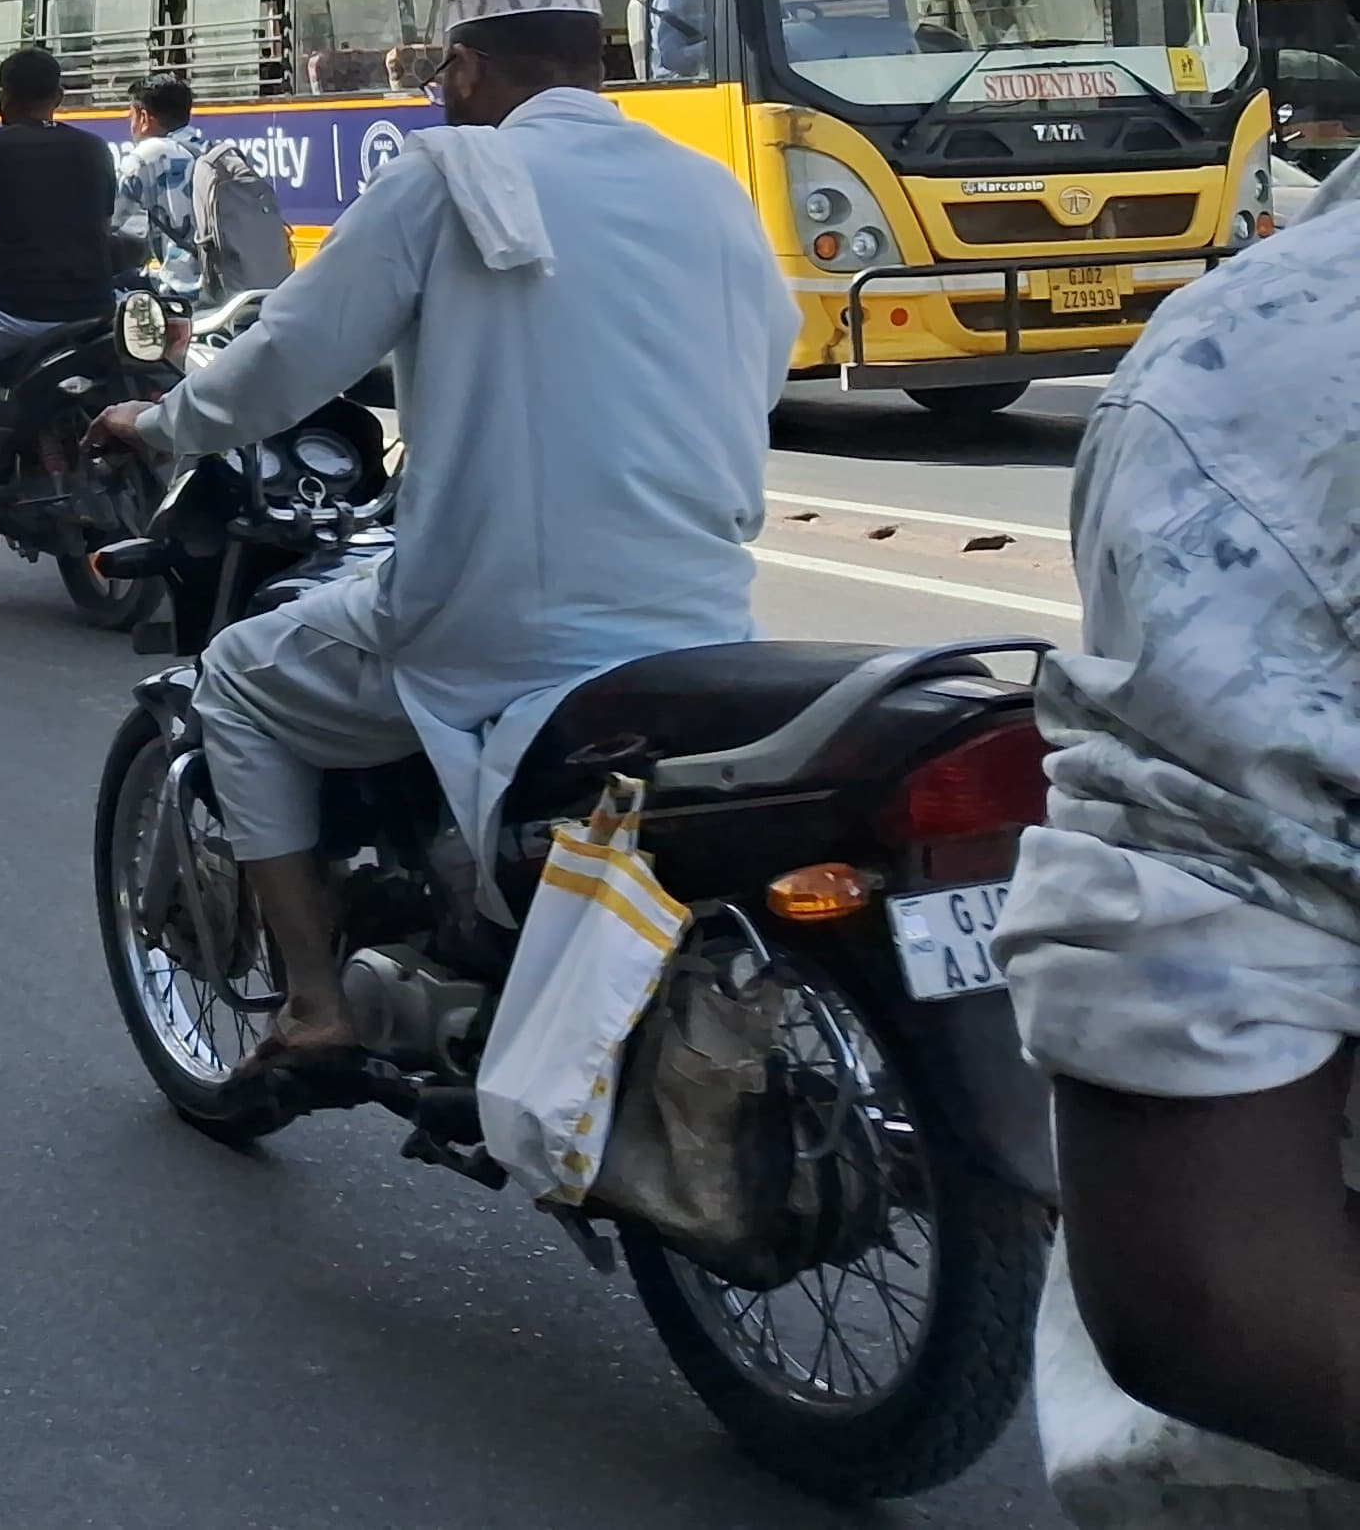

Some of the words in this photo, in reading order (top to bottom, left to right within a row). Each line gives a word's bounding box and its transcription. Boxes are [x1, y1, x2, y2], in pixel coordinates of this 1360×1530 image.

[983, 73, 1075, 101] STUDENT
[1078, 71, 1117, 98] BUS
[1032, 123, 1086, 142] TATA
[977, 181, 1044, 193] Marcopolo
[1061, 289, 1115, 310] ZZ9939
[943, 940, 991, 989] AJ
